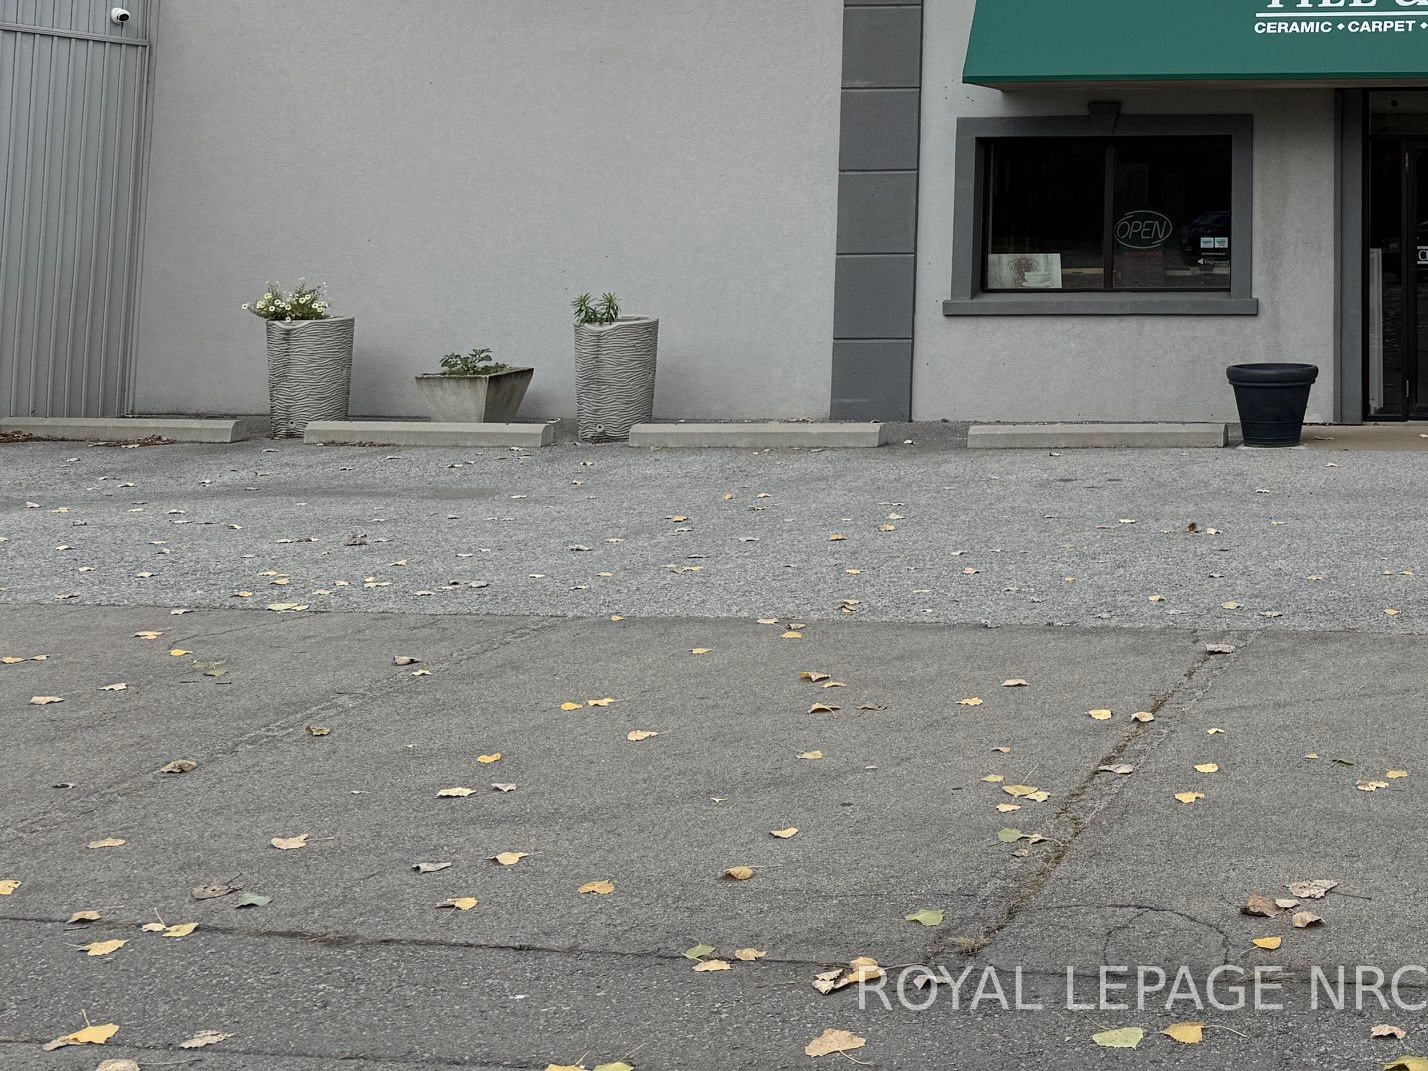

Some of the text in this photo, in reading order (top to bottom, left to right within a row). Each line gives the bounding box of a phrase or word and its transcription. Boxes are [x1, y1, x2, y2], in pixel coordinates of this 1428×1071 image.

[1254, 21, 1332, 34] CERAMIC
[1347, 20, 1416, 33] CARPET
[1116, 220, 1167, 239] OPEN
